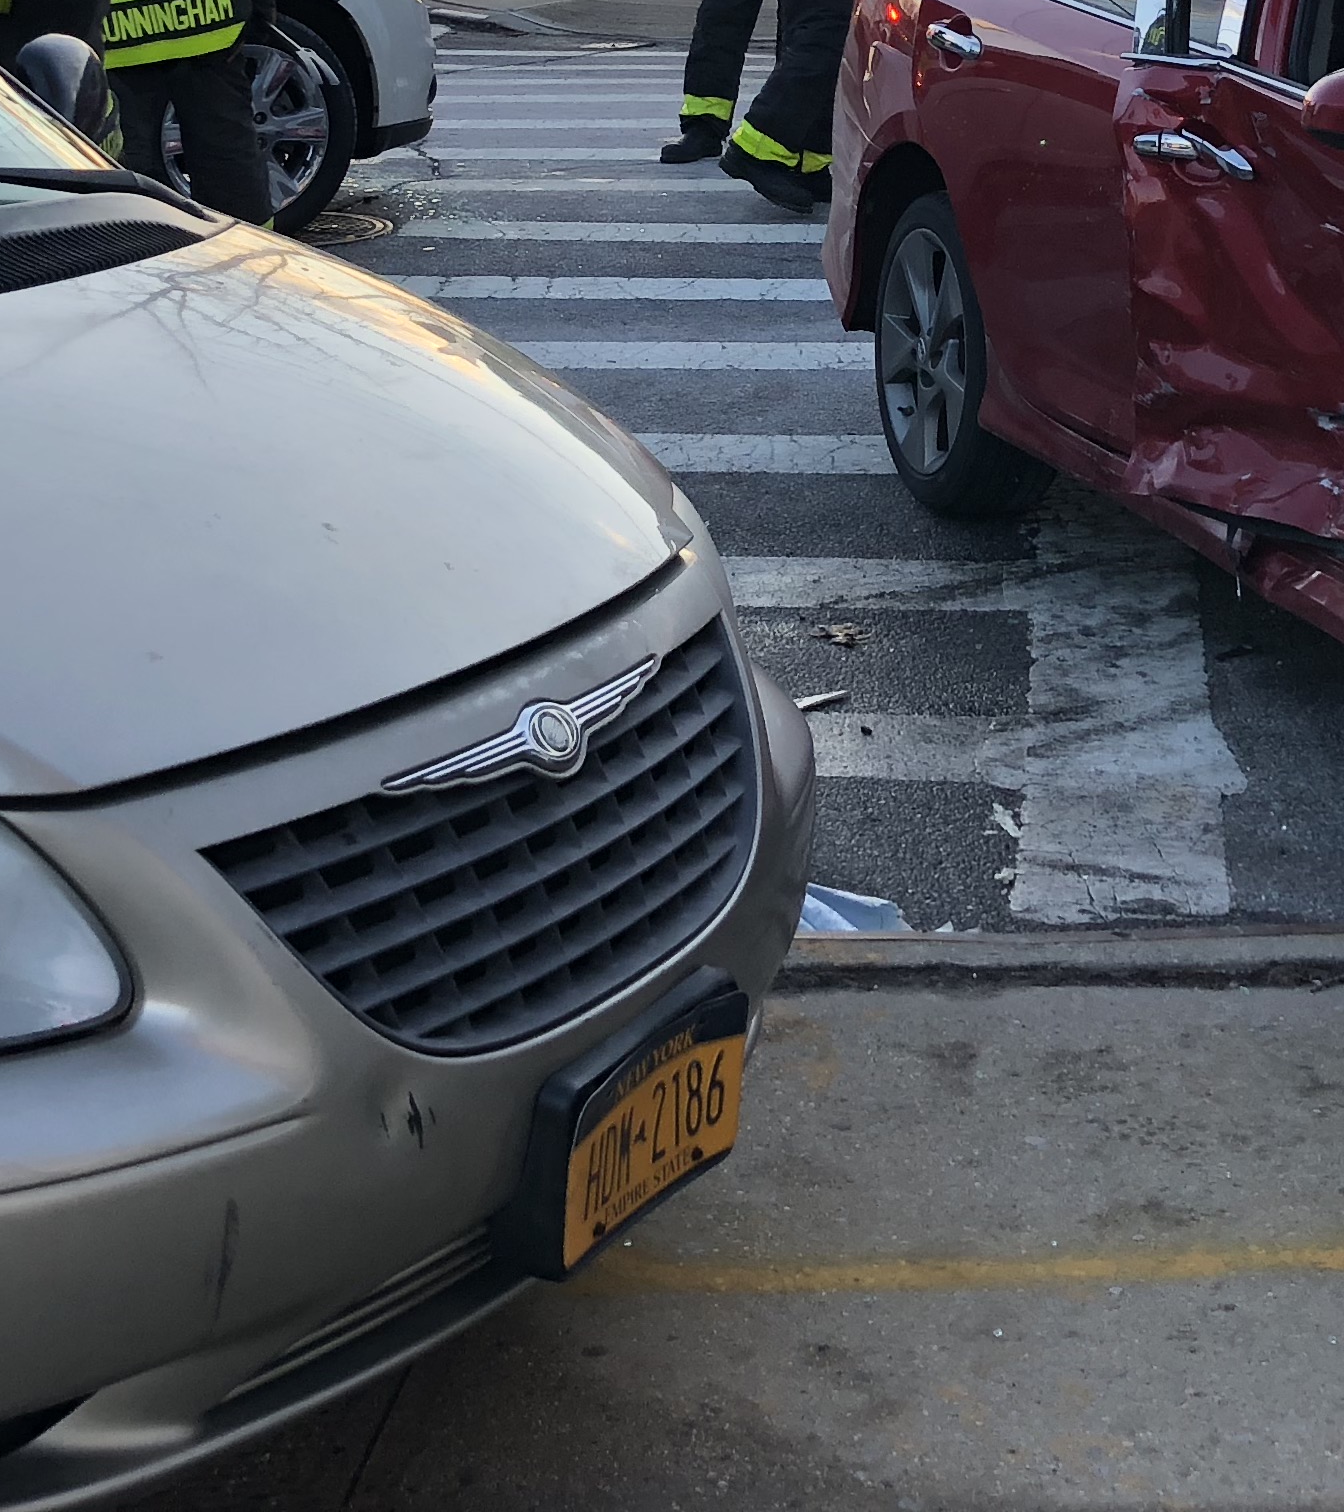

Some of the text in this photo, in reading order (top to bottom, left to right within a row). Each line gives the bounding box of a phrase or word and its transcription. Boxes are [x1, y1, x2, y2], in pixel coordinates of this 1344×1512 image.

[616, 1026, 696, 1100] NEW YORK
[604, 1147, 691, 1225] EMPIRE STATE
